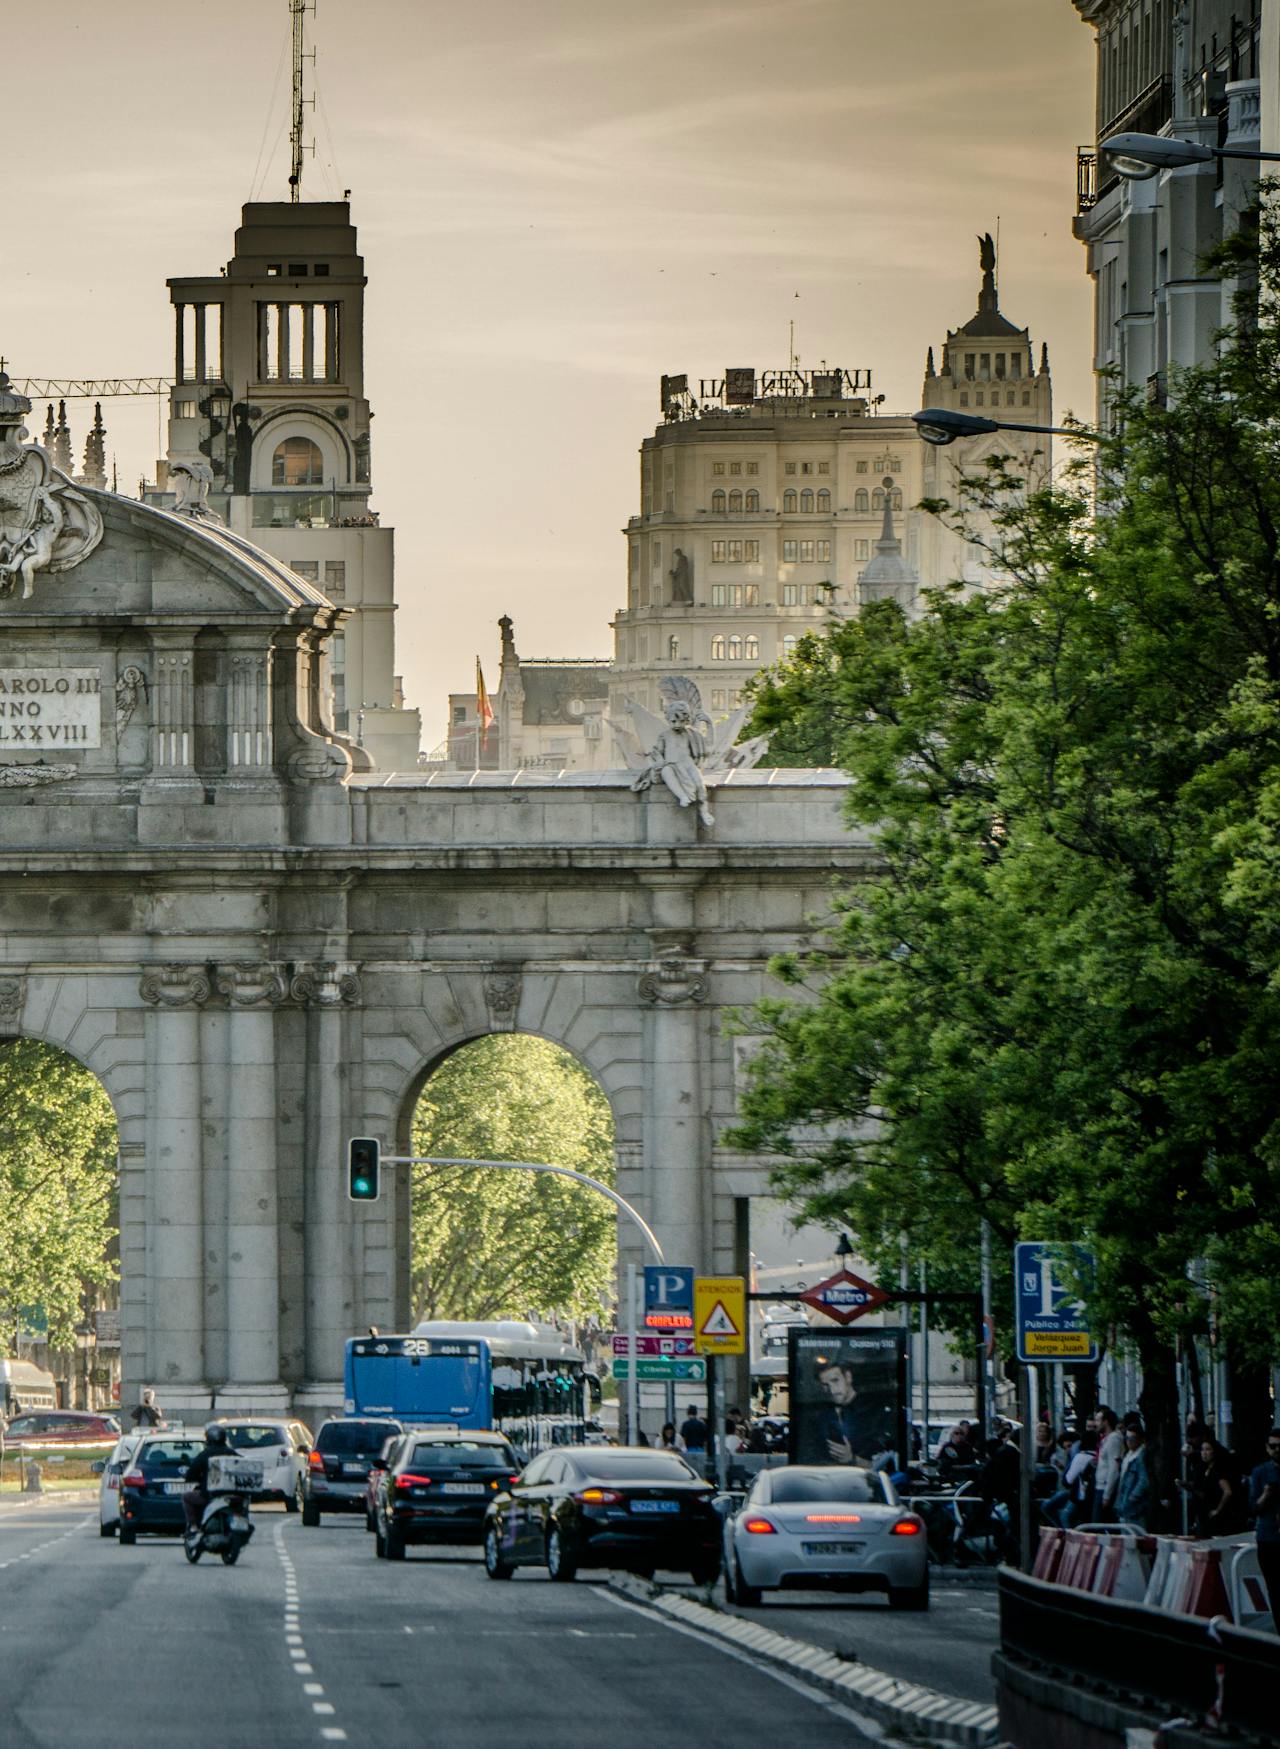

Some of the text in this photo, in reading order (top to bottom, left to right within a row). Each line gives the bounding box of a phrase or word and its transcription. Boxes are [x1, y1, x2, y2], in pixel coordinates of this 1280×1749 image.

[761, 369, 872, 388] GENALI
[76, 678, 102, 693] III
[657, 1275, 685, 1304] P
[825, 1290, 865, 1304] Metro
[1061, 1344, 1084, 1352] Juan
